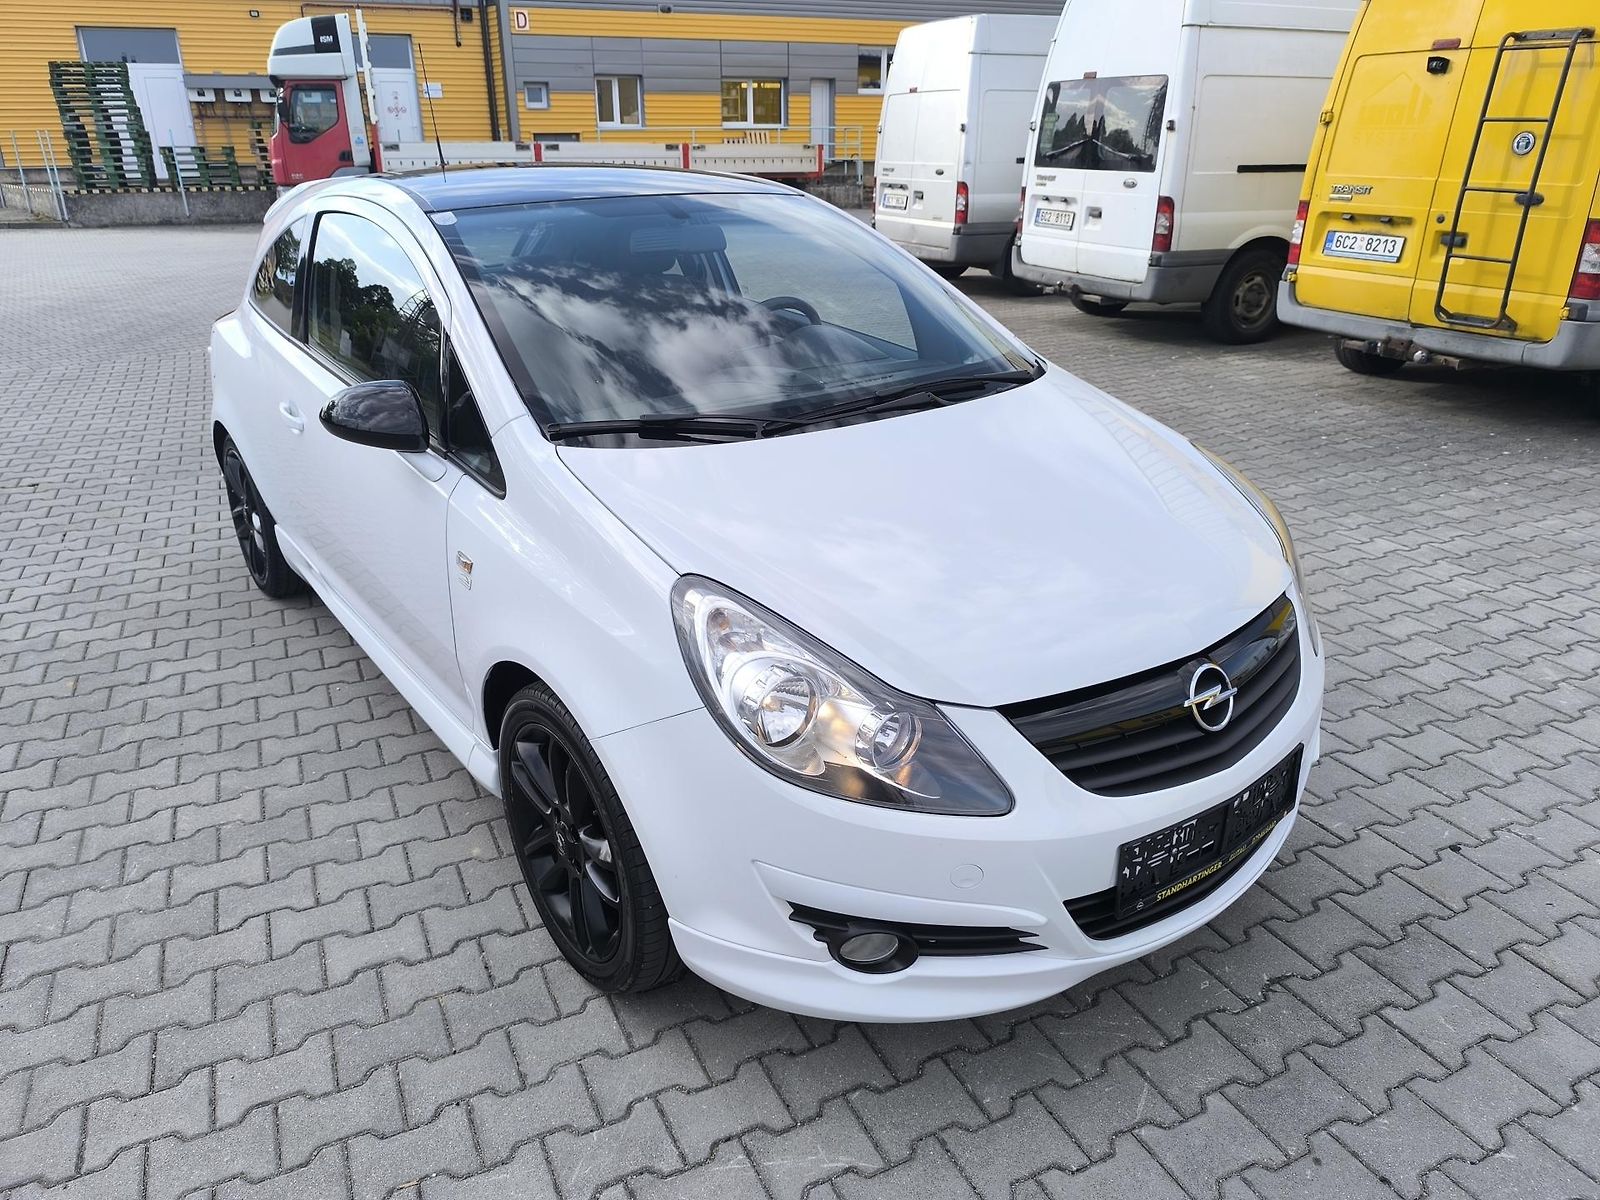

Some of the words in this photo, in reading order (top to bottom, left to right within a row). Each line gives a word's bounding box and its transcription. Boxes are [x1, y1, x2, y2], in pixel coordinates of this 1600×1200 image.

[515, 11, 527, 29] D
[1331, 184, 1374, 195] TRANSIT
[1335, 235, 1358, 250] 6C2
[1365, 237, 1397, 254] 8213
[1157, 861, 1223, 902] STANDHARTINGER
